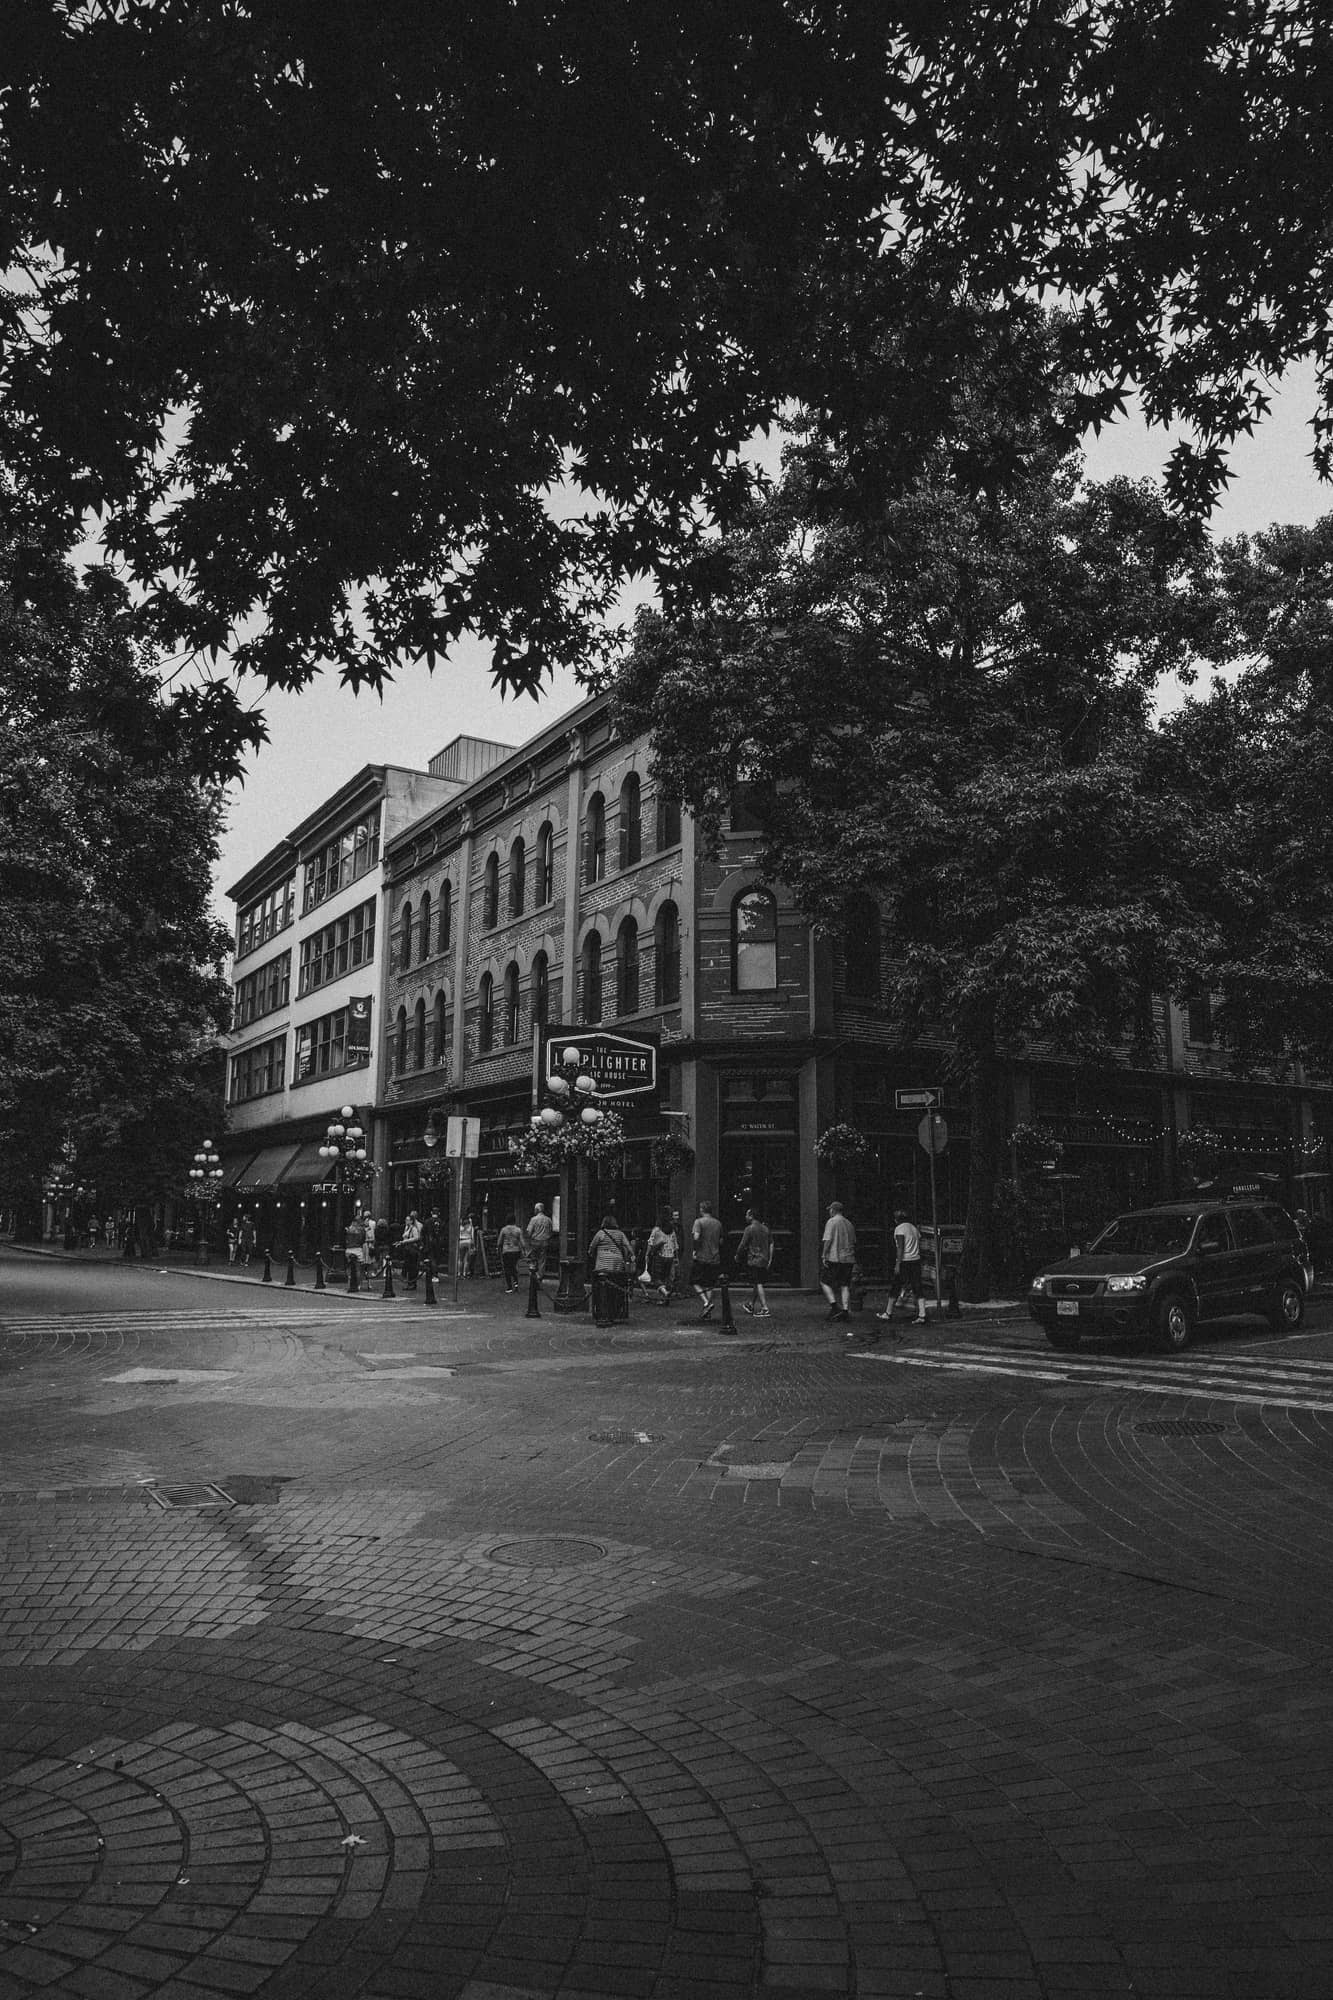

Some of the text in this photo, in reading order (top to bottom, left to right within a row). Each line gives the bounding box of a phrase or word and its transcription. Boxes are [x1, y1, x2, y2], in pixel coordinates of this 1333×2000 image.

[596, 1046, 607, 1054] THE
[553, 1051, 647, 1072] LPLIGHTER
[610, 1100, 636, 1108] HOTEL
